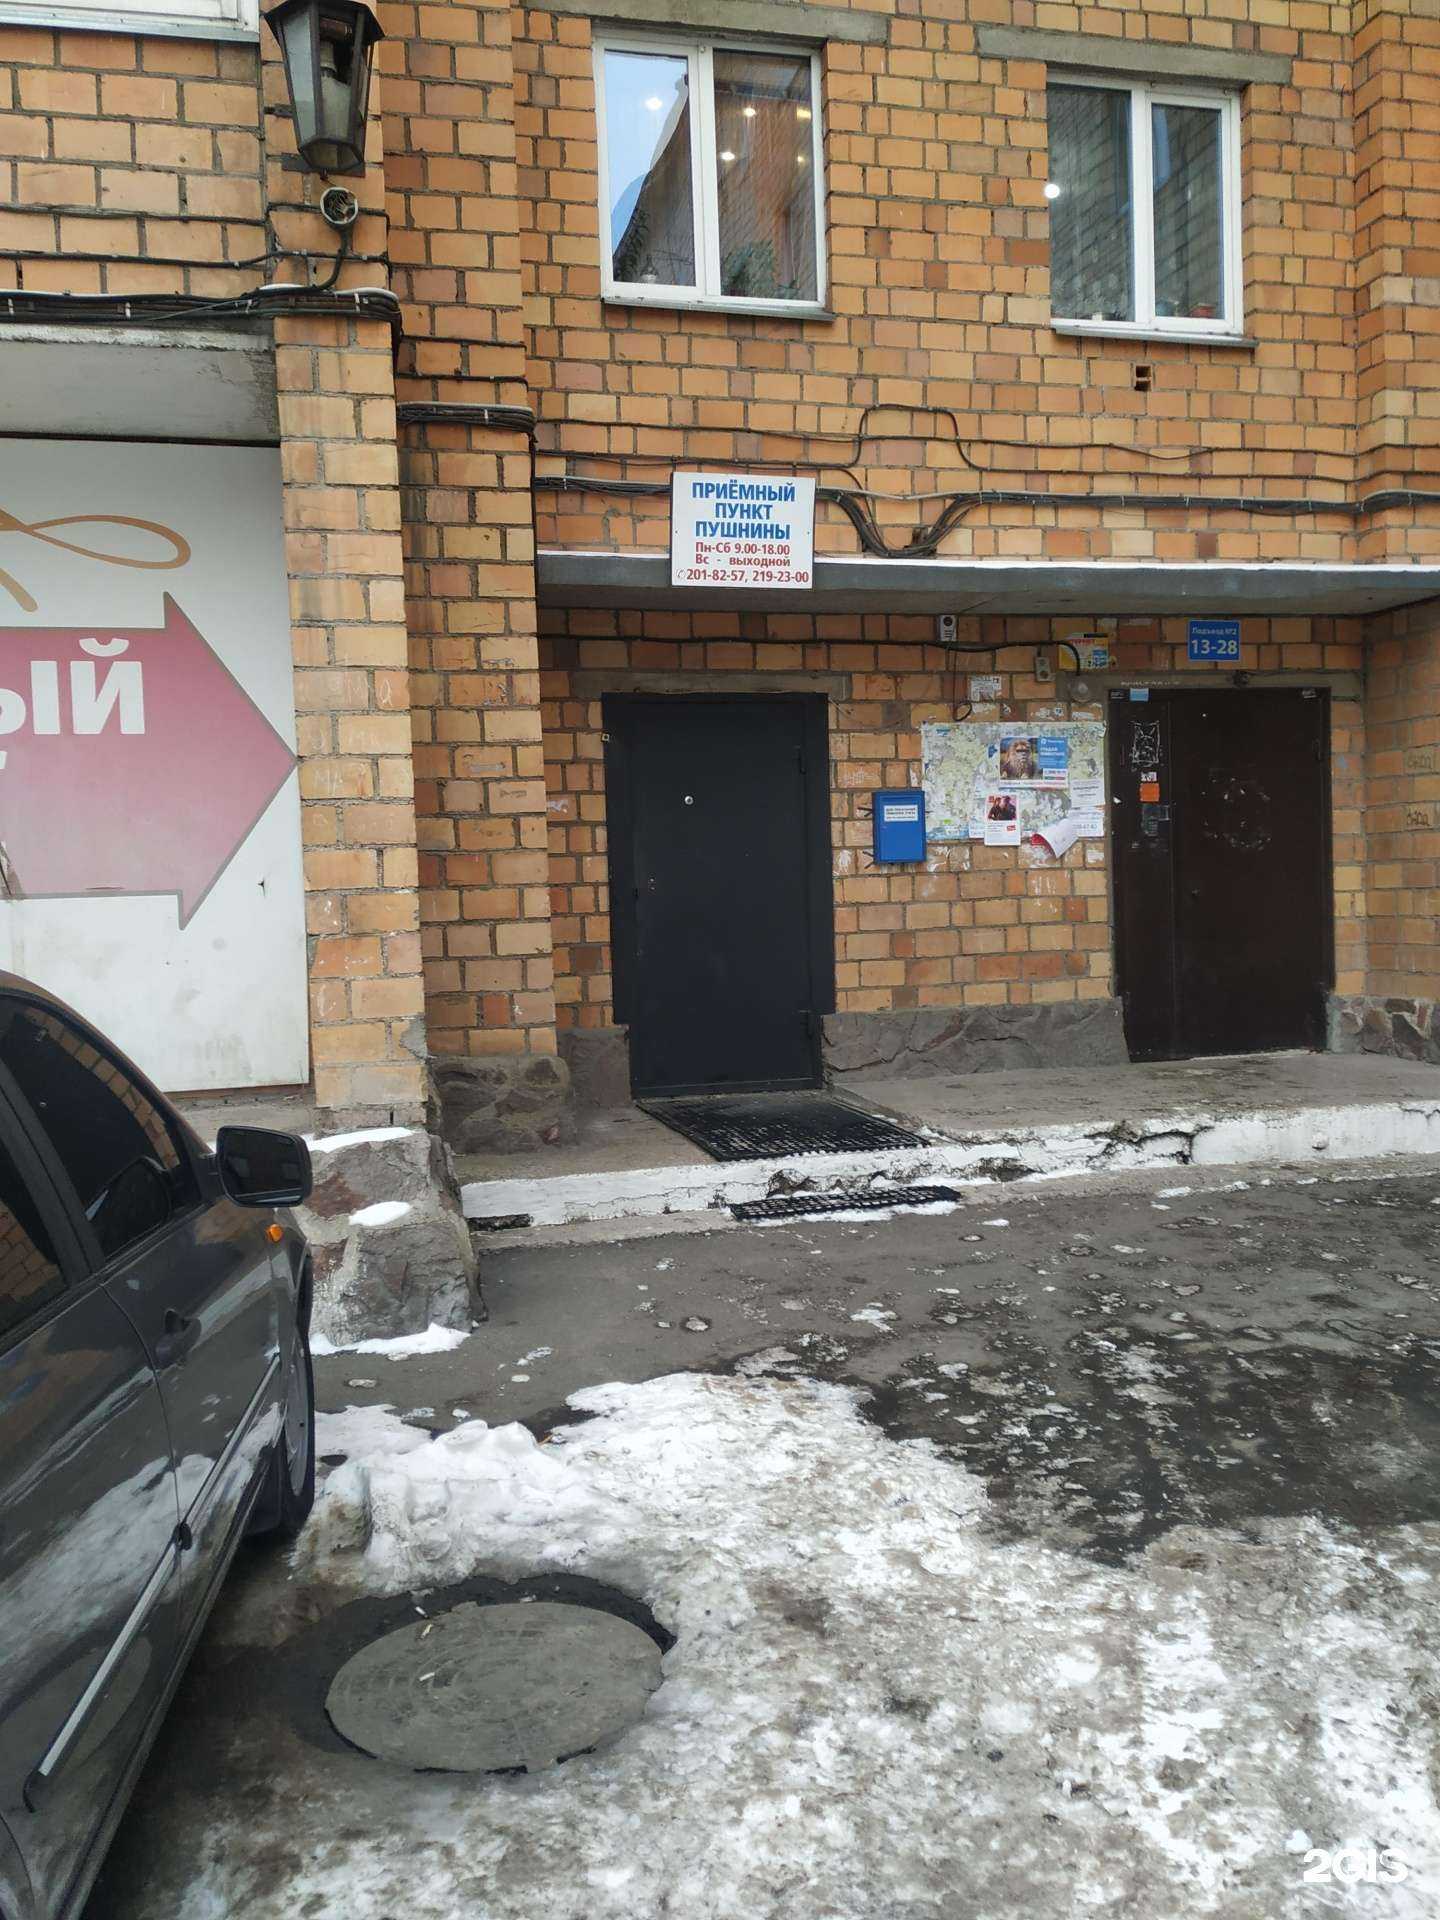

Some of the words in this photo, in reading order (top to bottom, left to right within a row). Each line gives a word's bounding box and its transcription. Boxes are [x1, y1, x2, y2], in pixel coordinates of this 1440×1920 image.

[692, 479, 796, 502] ПРИЁМНЫЙ
[715, 503, 773, 520] ПУНКТ
[695, 521, 790, 540] ПУШНИНЫ
[695, 541, 731, 553] Пн-Сб
[734, 544, 790, 555] 9.00-18.00
[695, 553, 710, 565] Вс
[729, 556, 791, 567] выходной
[686, 568, 748, 582] 201-82-57,
[752, 571, 809, 583] 219-23-00
[1191, 639, 1238, 655] 13-28
